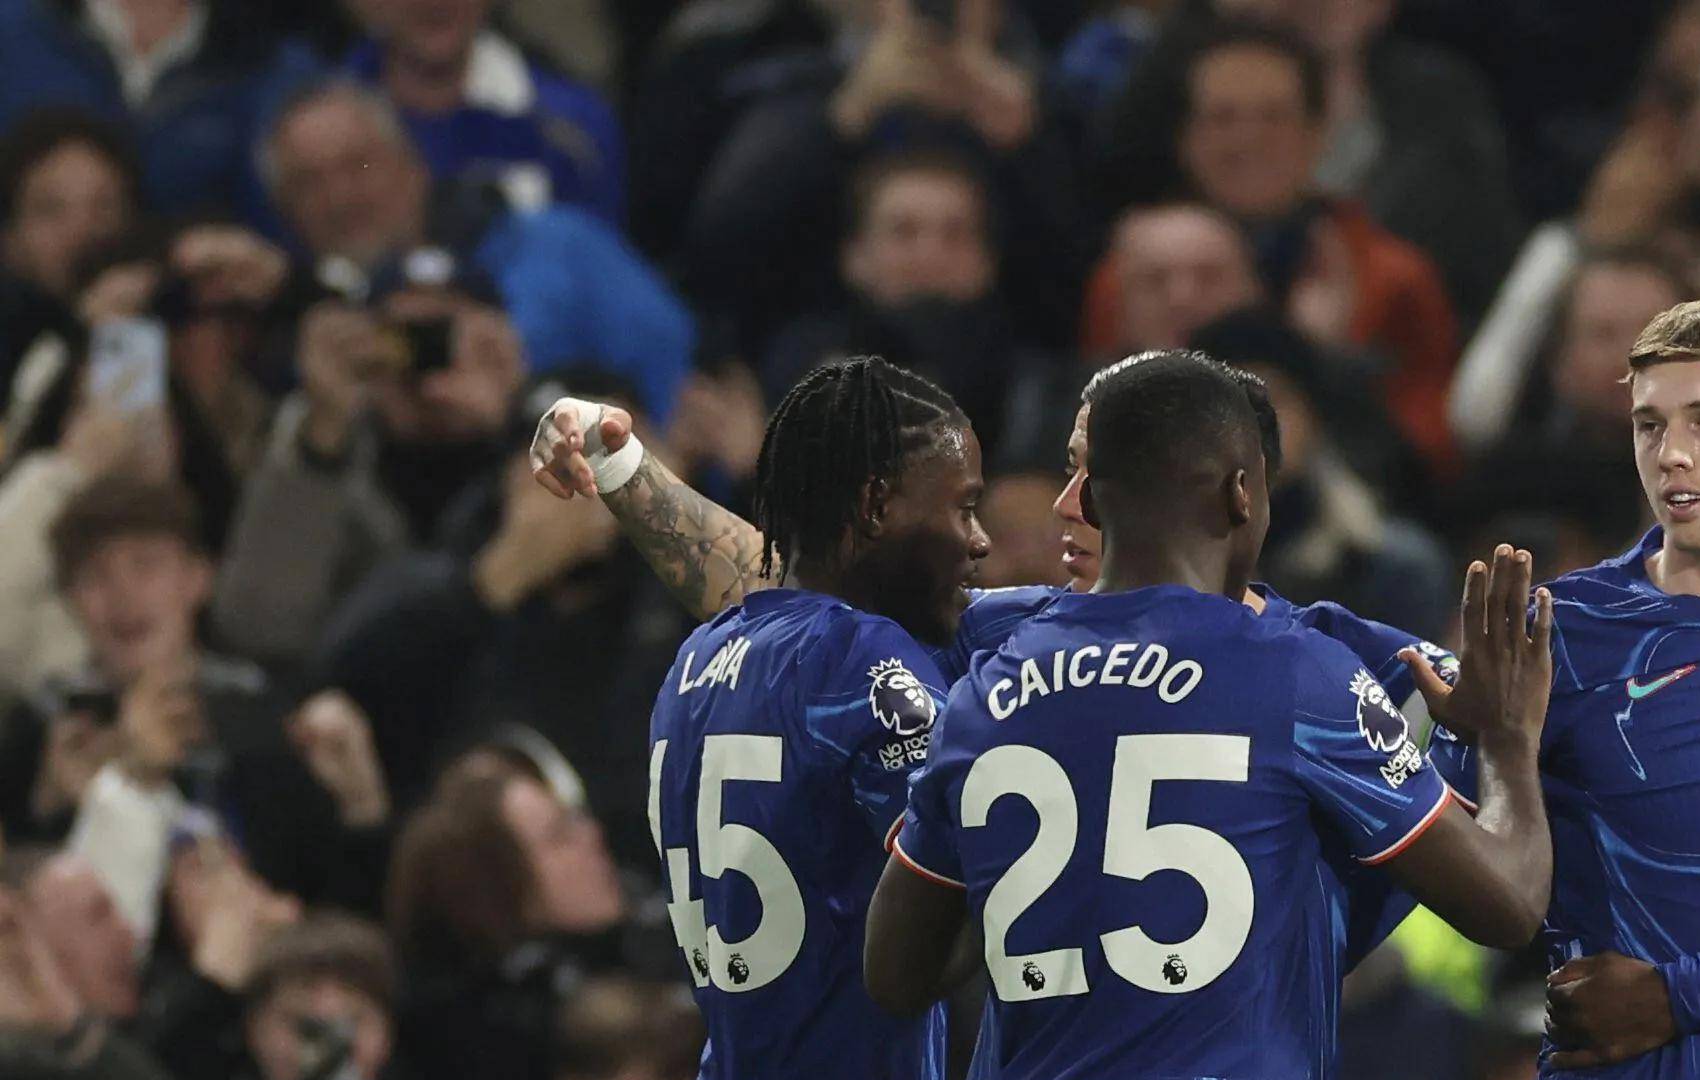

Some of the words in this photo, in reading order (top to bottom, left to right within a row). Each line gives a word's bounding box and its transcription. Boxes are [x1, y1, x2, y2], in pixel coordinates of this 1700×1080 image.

[988, 643, 1203, 721] CAICEDO
[879, 743, 902, 758] No
[903, 733, 931, 751] roo
[960, 733, 1254, 1002] 25
